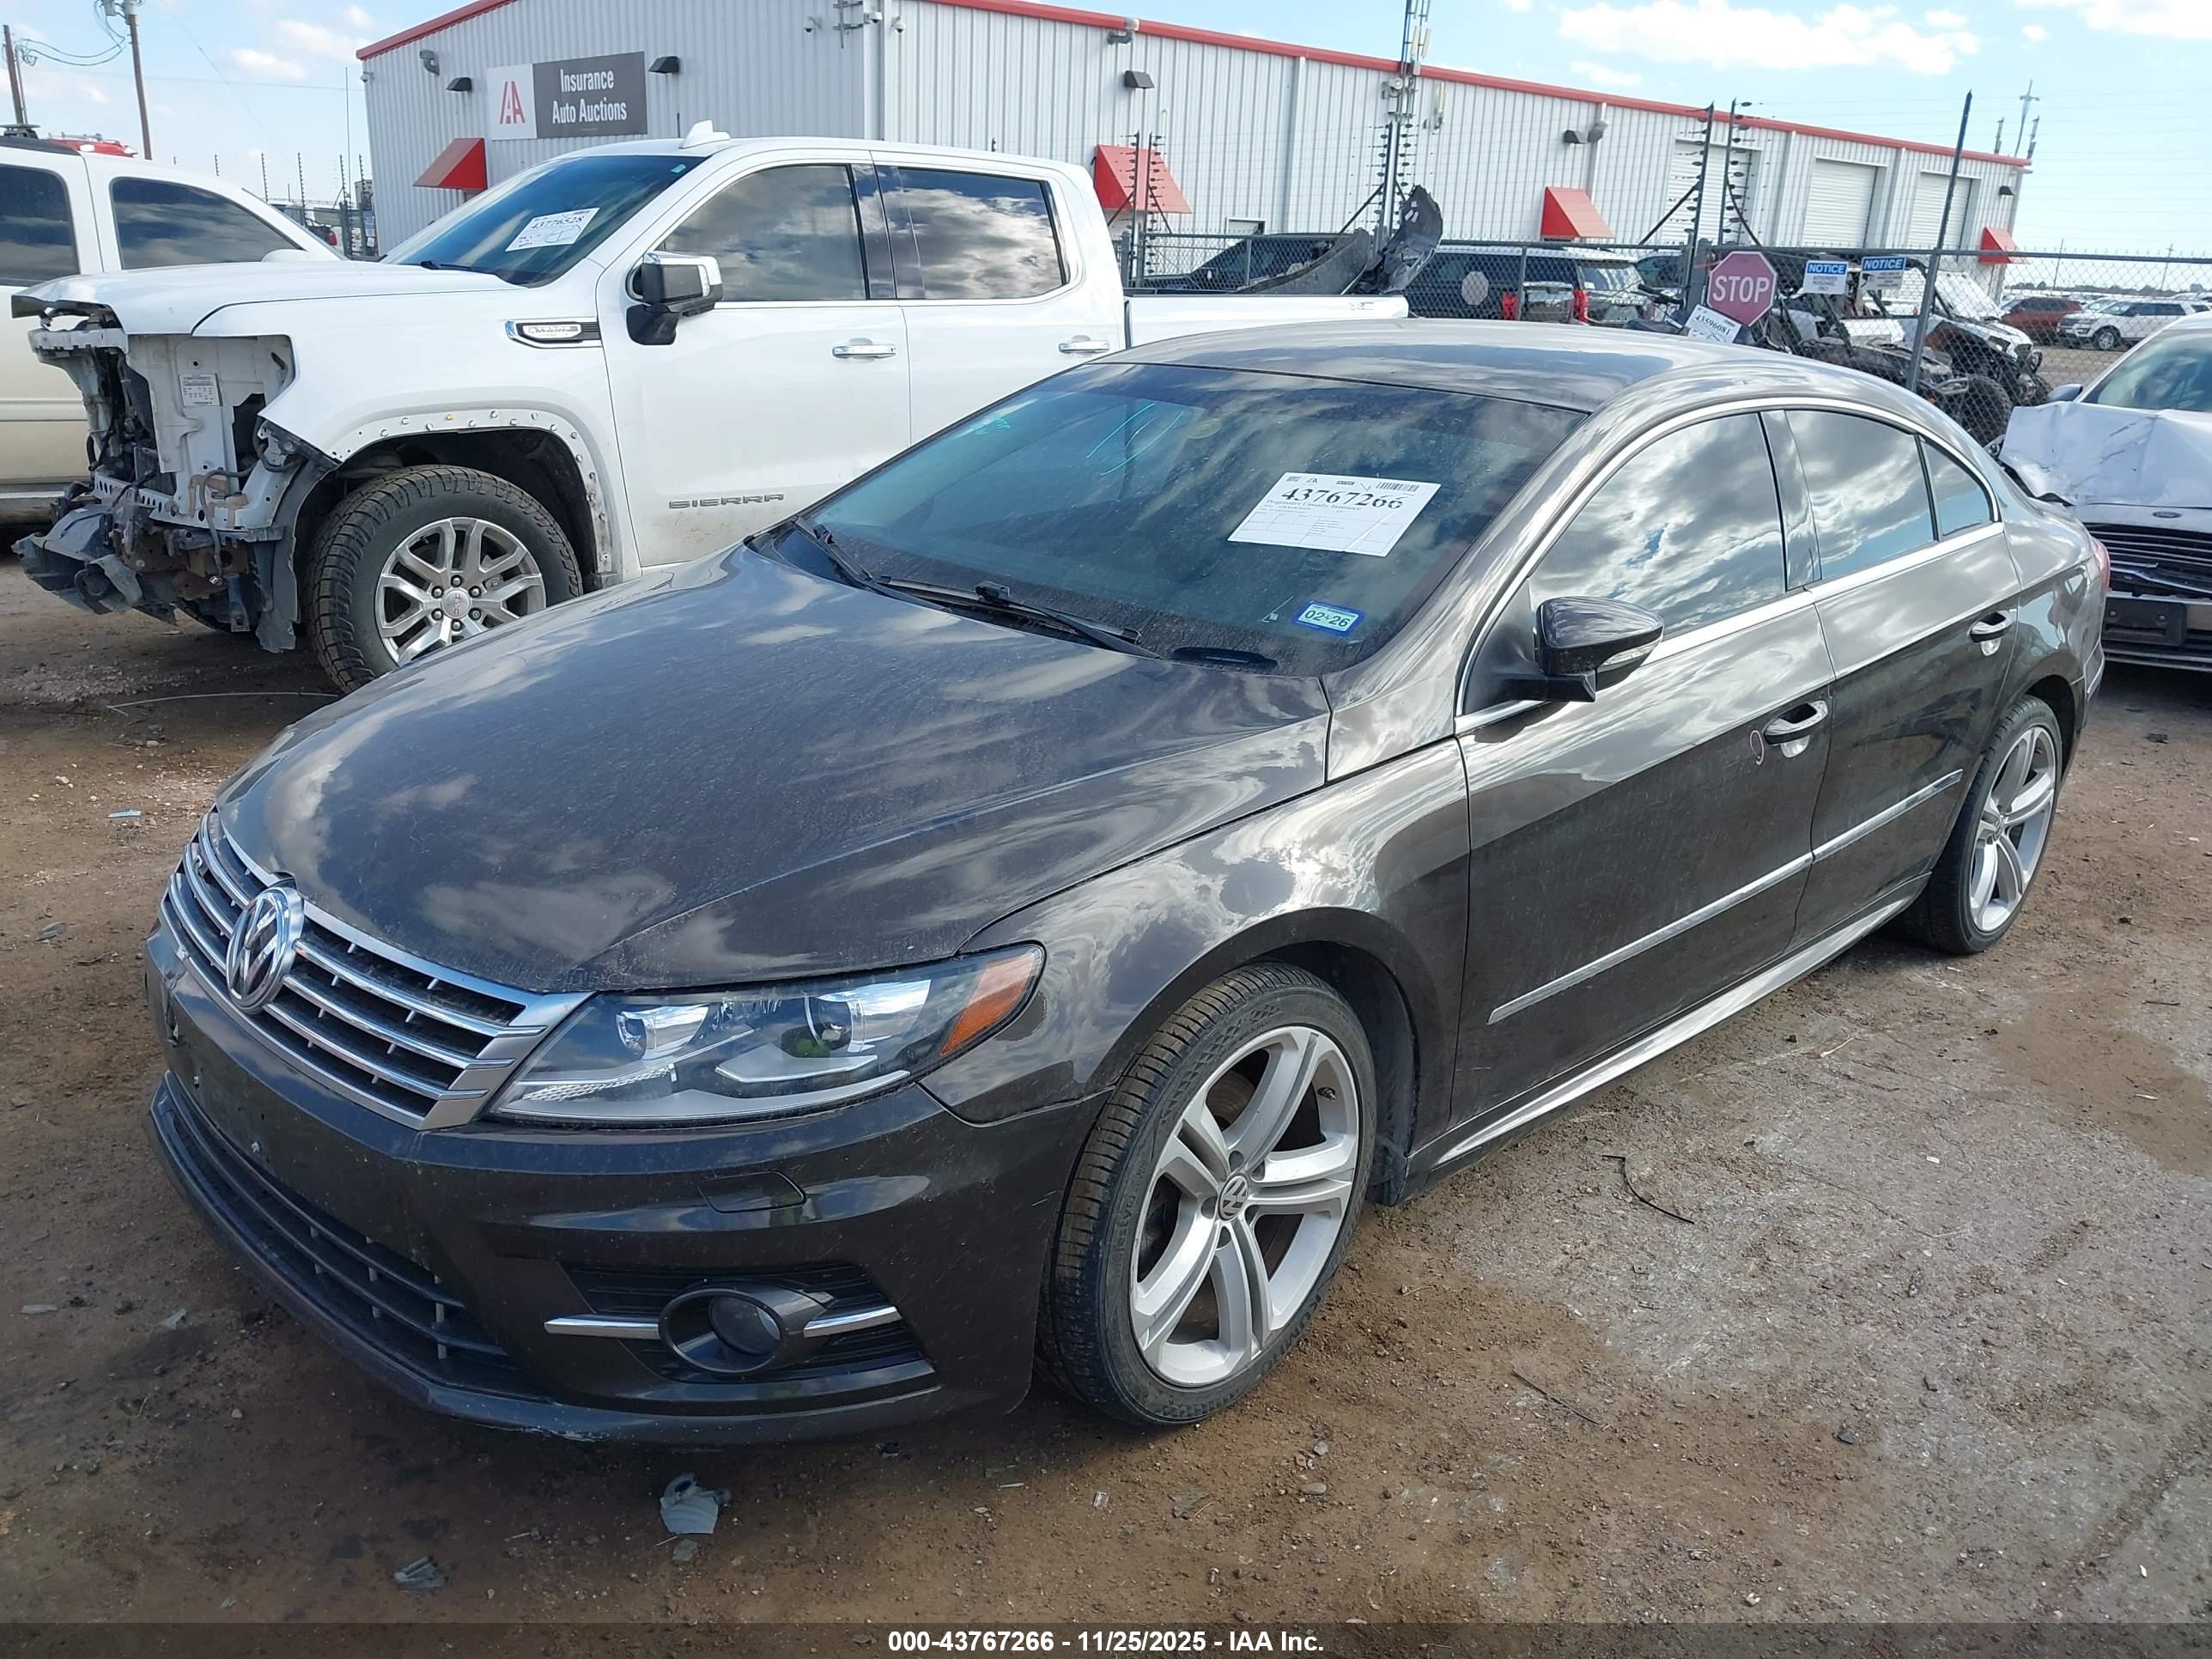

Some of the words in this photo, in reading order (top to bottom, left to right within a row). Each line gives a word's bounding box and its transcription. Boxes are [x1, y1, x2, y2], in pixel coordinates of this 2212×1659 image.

[560, 69, 615, 93] Insurance
[552, 100, 576, 124] Auto
[579, 97, 628, 123] Auctions
[1808, 264, 1845, 274] NOTICE
[1863, 258, 1904, 270] NOTICE
[1712, 275, 1770, 303] STOP
[1695, 314, 1731, 336] 43596081
[669, 493, 784, 509] SIERRA
[1281, 487, 1404, 510] 43767266
[1305, 610, 1351, 627] 02-26
